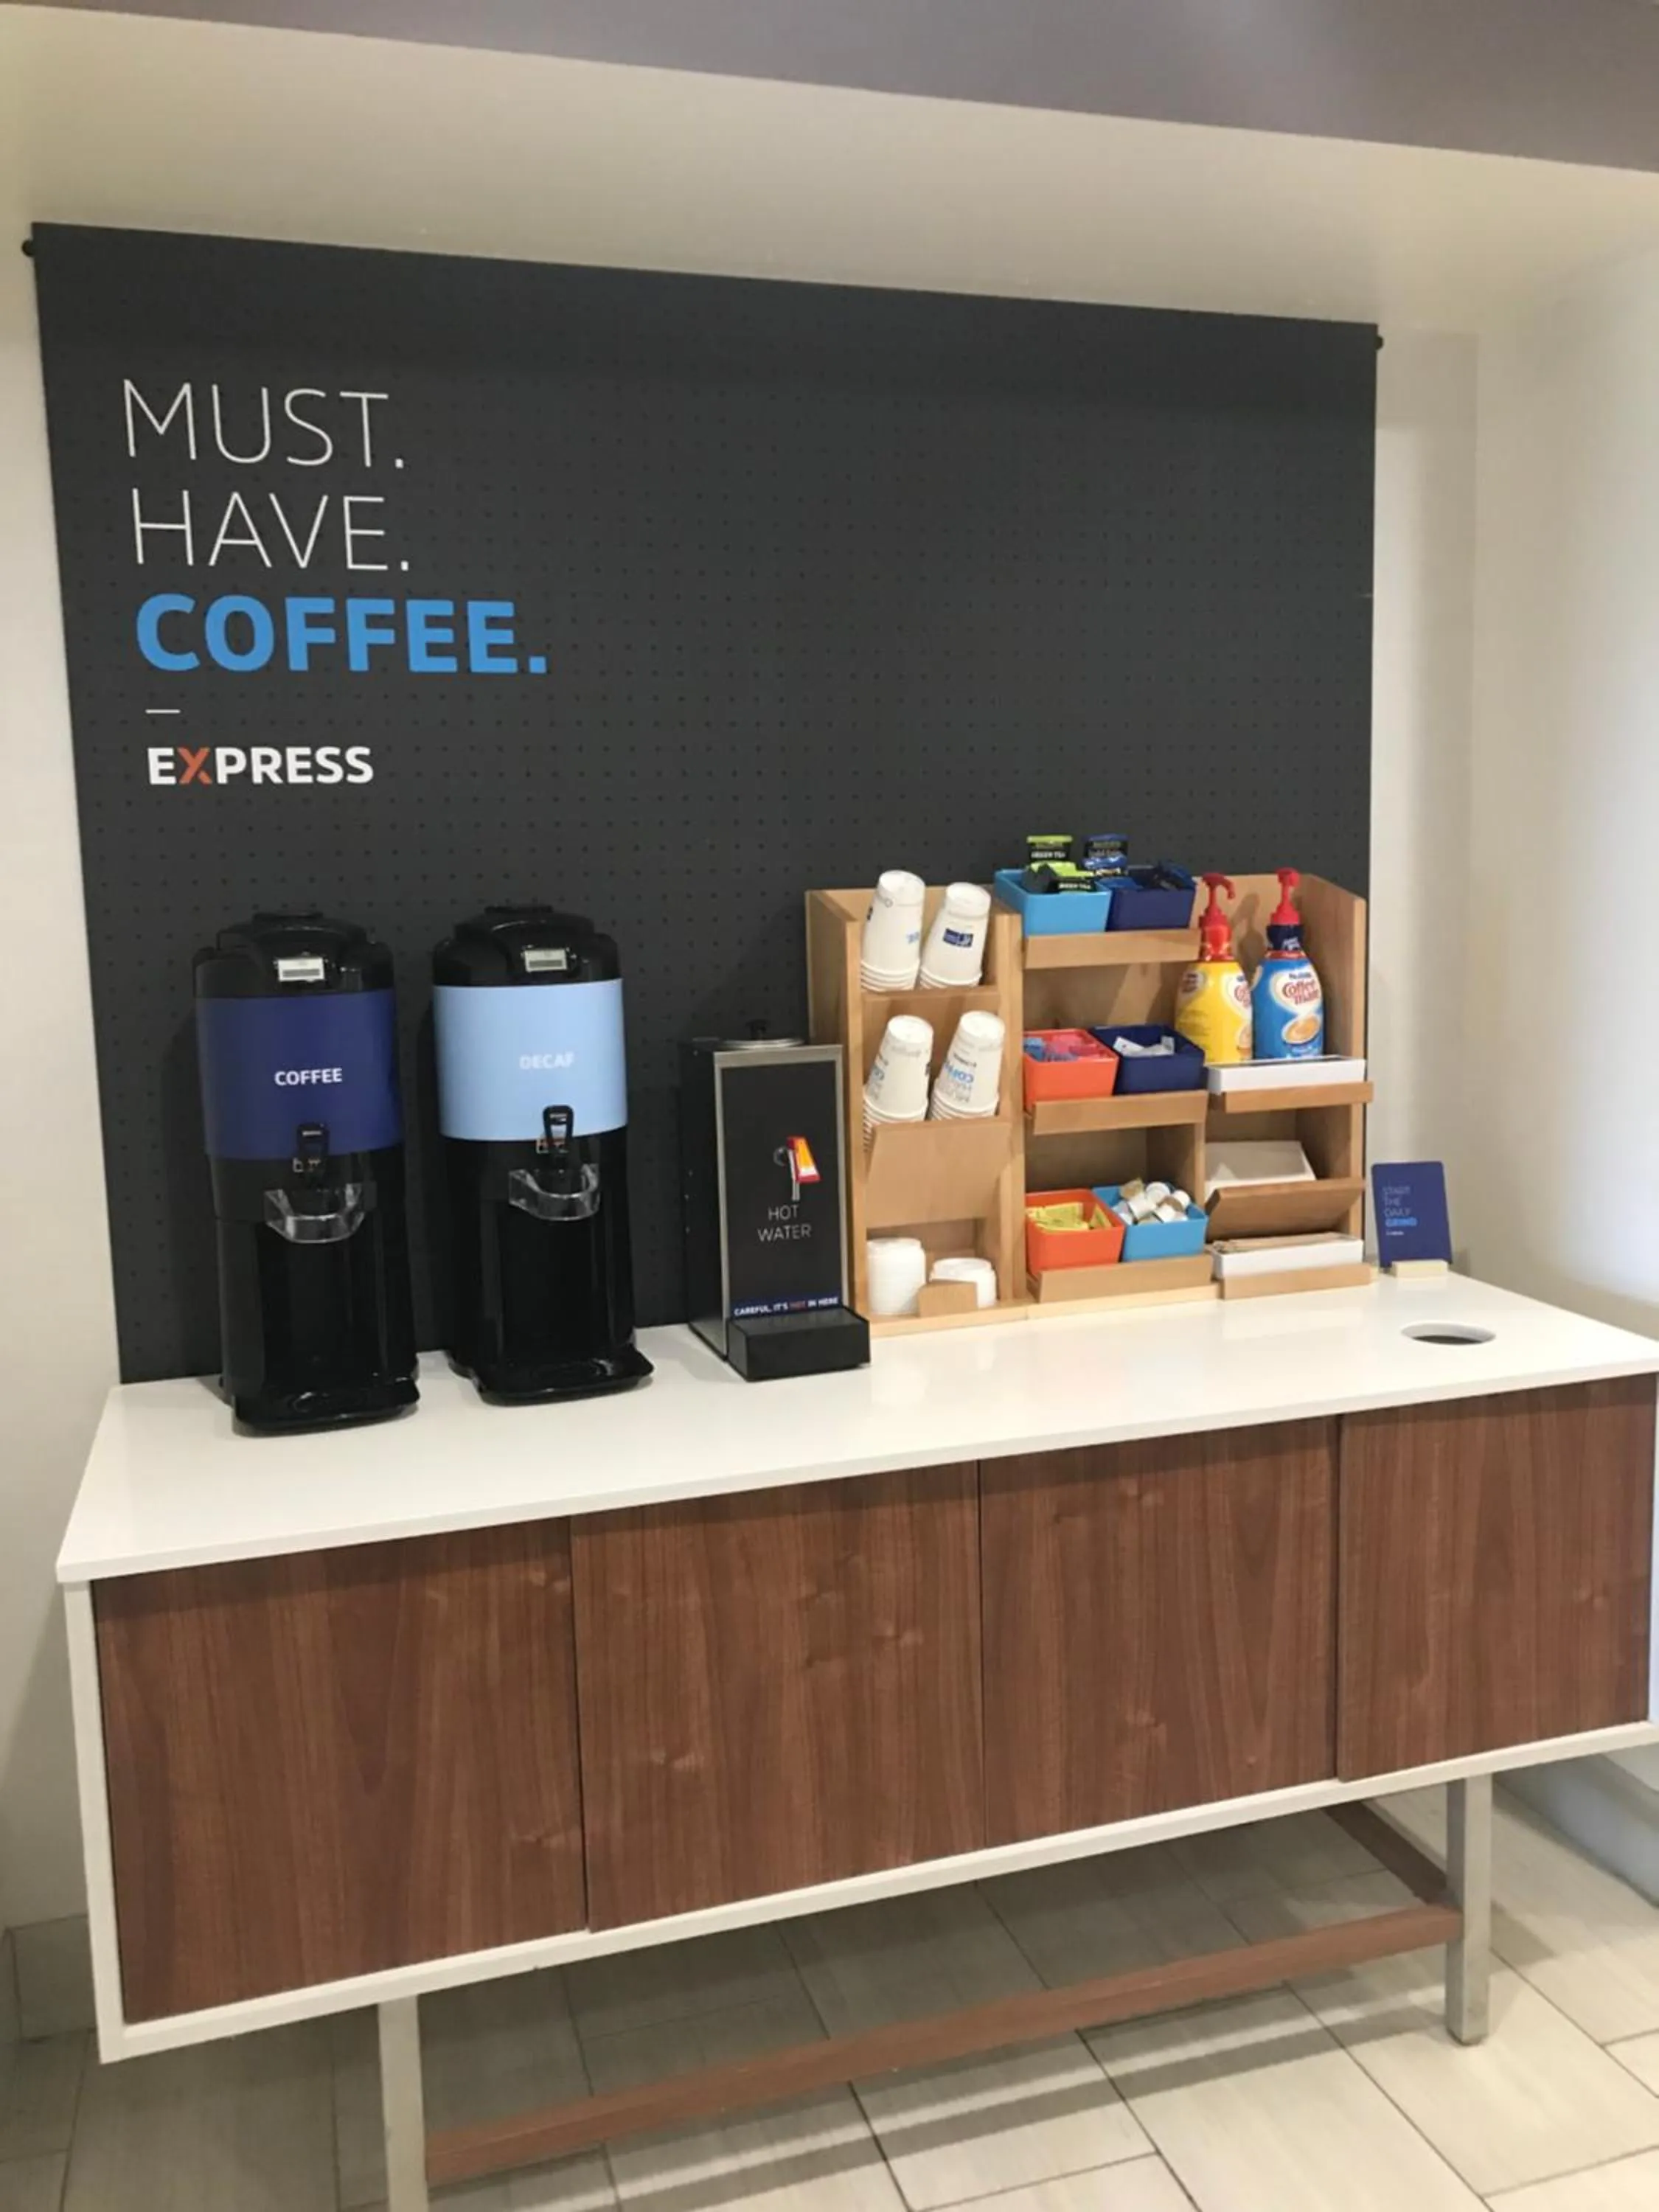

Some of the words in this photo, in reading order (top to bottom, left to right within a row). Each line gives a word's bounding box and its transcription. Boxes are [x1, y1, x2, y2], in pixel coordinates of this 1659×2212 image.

[124, 379, 403, 468] MUST.
[132, 488, 409, 571] HAVE.
[136, 593, 548, 674] COFFEE.
[147, 746, 374, 785] EXPRESS
[519, 1052, 576, 1070] DECAF
[274, 1068, 343, 1086] COFFEE
[768, 1204, 800, 1221] HOT
[757, 1223, 812, 1242] WATER
[734, 1304, 772, 1317] CAREFUL,
[773, 1302, 788, 1311] IT'S
